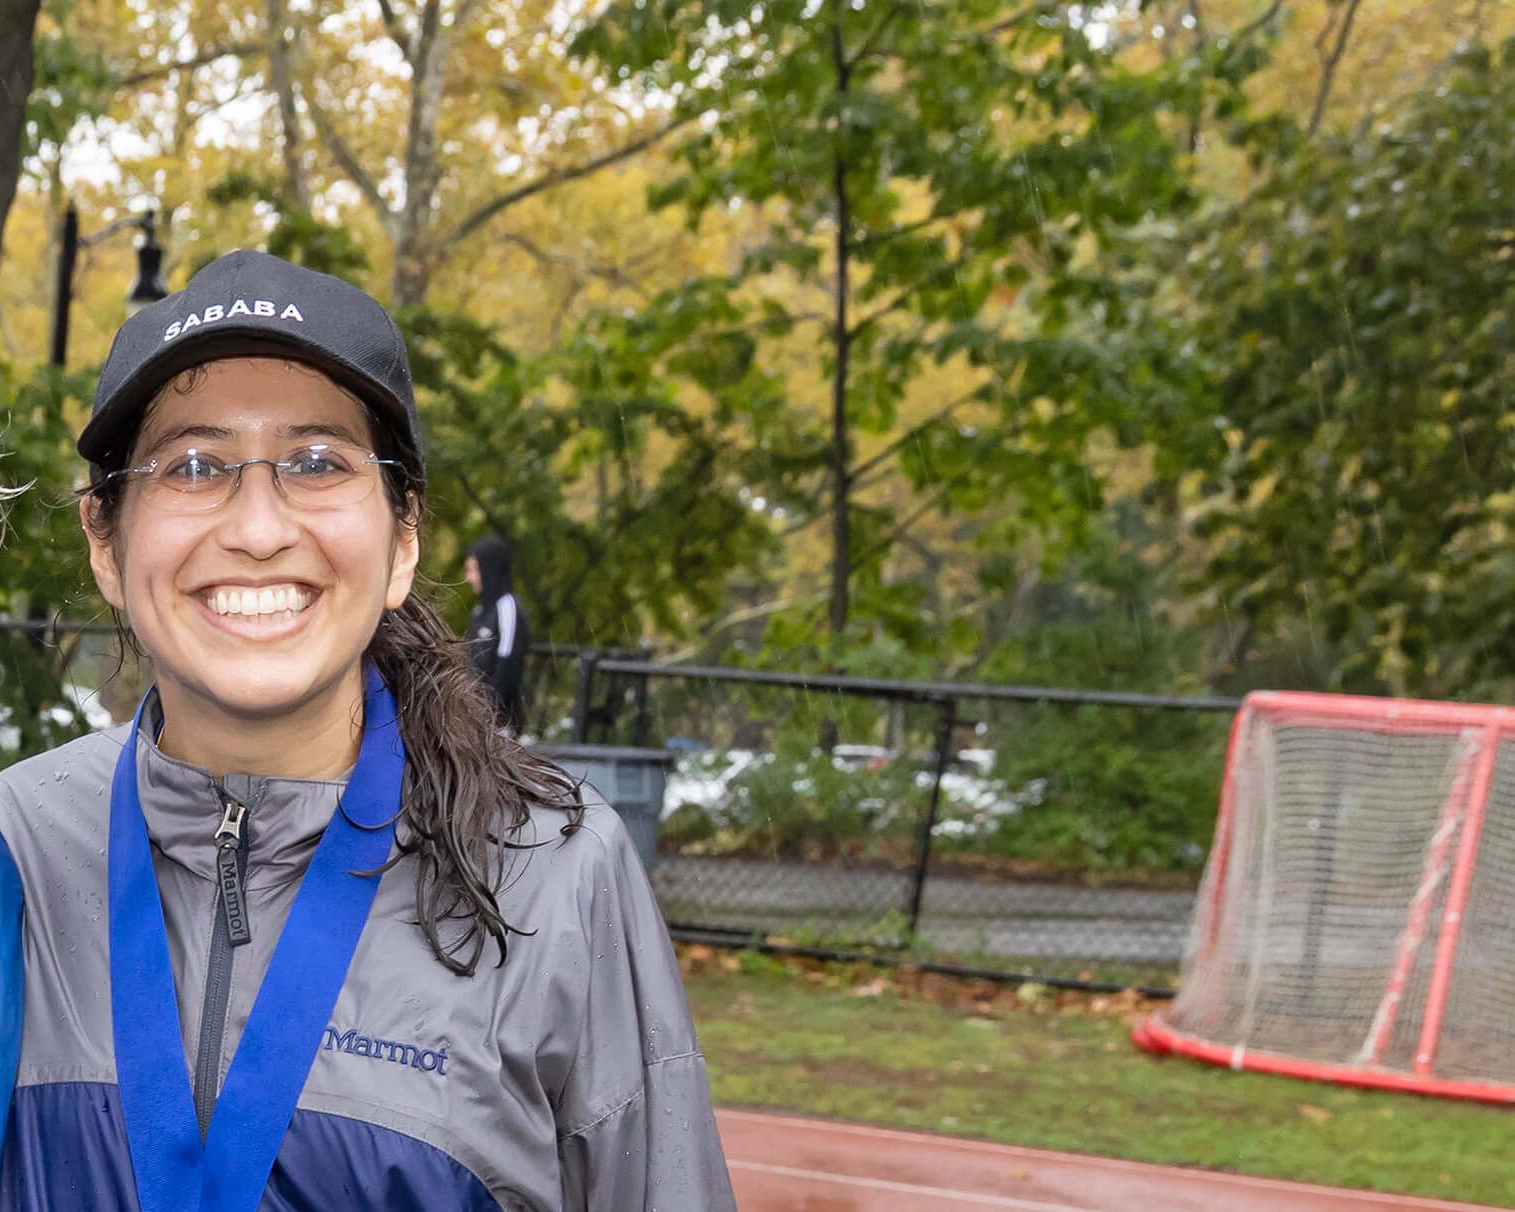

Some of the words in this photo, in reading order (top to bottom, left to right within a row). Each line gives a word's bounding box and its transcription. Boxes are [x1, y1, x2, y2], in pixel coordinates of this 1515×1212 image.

[164, 299, 303, 342] SABABA
[221, 862, 246, 938] Marmot
[324, 1026, 449, 1075] Marmot
